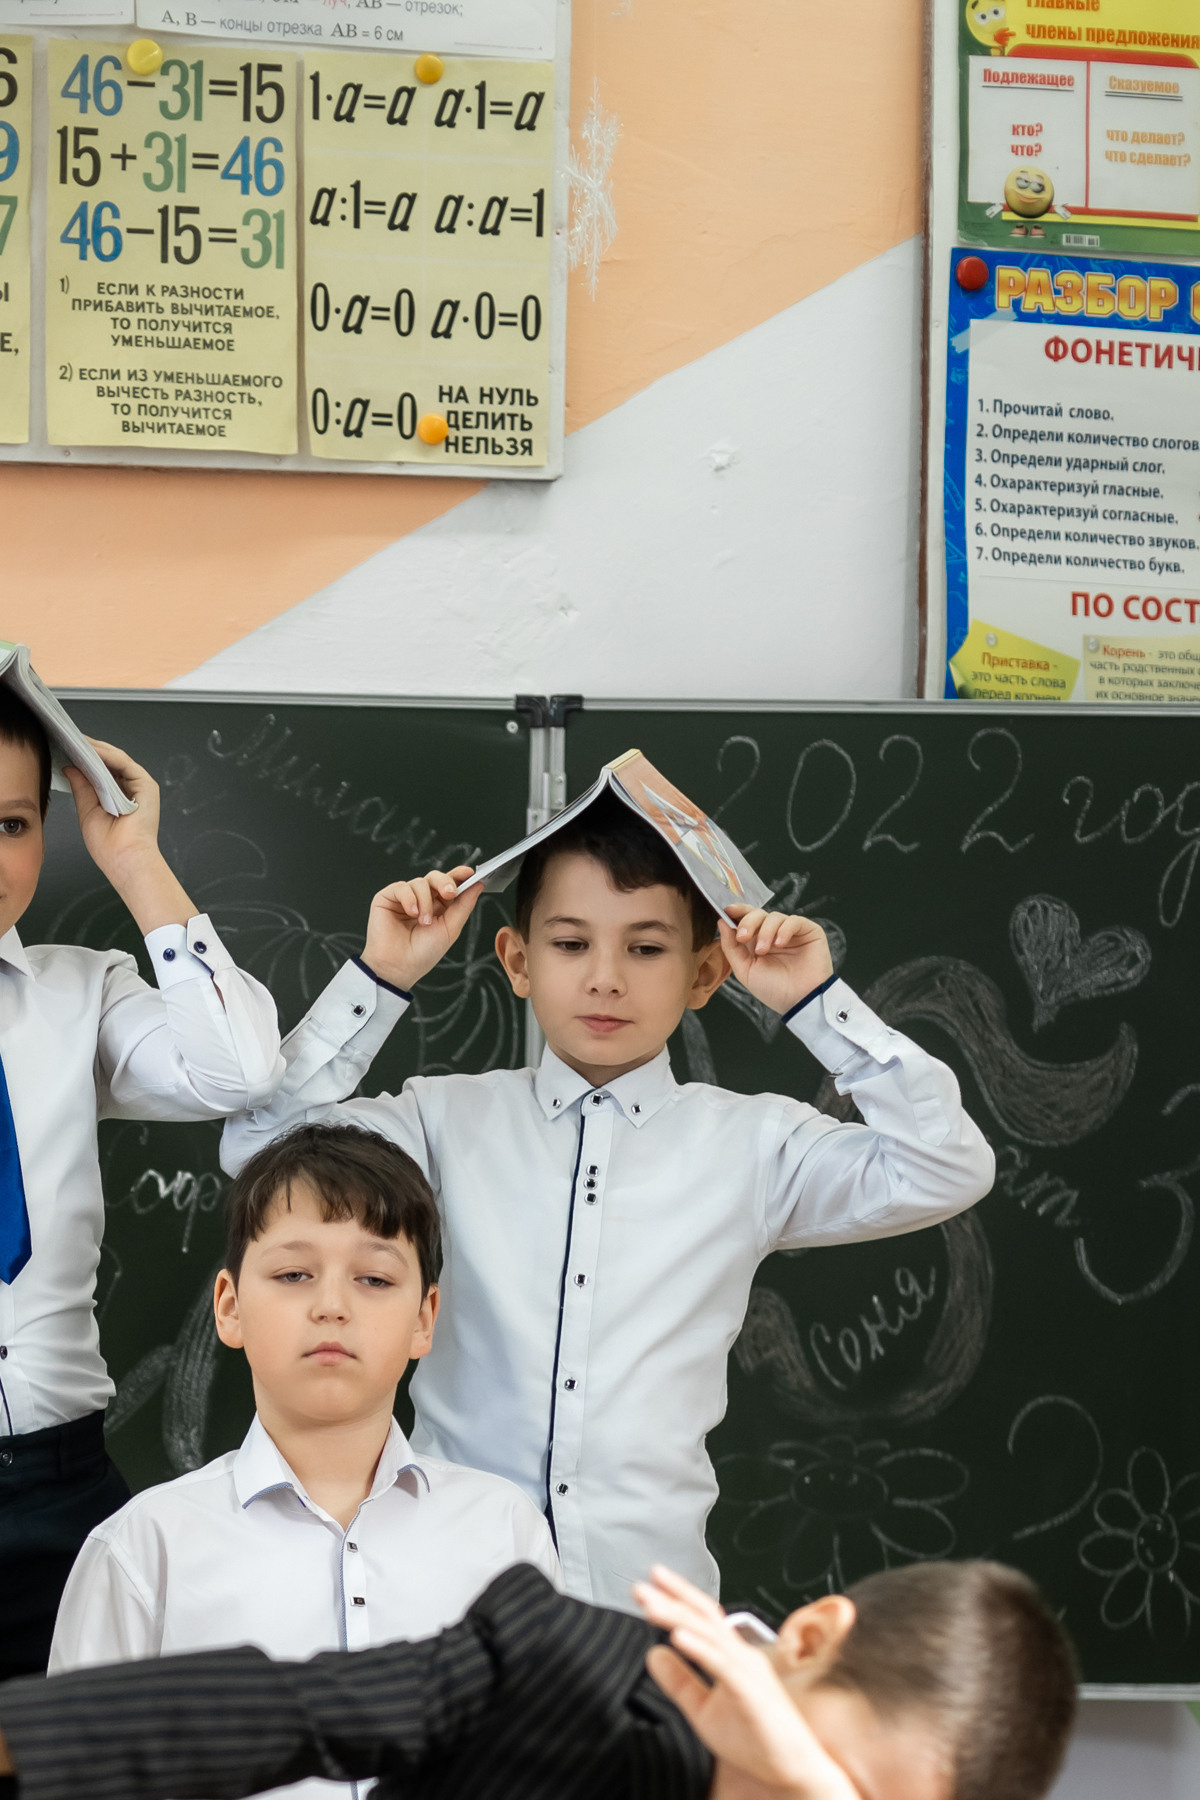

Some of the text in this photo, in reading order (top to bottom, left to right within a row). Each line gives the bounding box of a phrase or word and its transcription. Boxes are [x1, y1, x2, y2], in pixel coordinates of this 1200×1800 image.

[219, 17, 262, 33] концы
[267, 20, 323, 37] отрезка
[374, 26, 383, 41] 6
[386, 29, 404, 41] см
[1026, 24, 1200, 49] члены предложения
[983, 68, 1075, 88] Подлежащее
[1108, 75, 1180, 94] Сказуемое
[1012, 123, 1043, 137] кто?
[1106, 129, 1185, 146] что делает?
[1010, 143, 1043, 157] что?
[1105, 150, 1191, 167] что сделает?
[97, 282, 139, 296] ЕСЛИ
[146, 284, 155, 296] К
[161, 286, 244, 300] РАЗНОСТИ
[995, 265, 1179, 322] РАЗБОР
[72, 298, 280, 320] ПРИБАВИТЬ ВЫЧИТАЕМОЕ,
[111, 317, 232, 334] ТО ПОЛУЧИТСЯ
[111, 335, 235, 351] УМЕНЬШАЕМОЕ
[59, 363, 283, 388] 2) ЕСЛИ ИЗ УМЕНЬШАЕМОГО
[97, 386, 263, 406] ВЫЧЕСТЬ РАЗНОСТЬ,
[437, 384, 539, 407] НА НУЛЬ
[111, 403, 232, 420] ТО ПОЛУЧИТСЯ
[978, 399, 1114, 421] 1. Прочитай слово.
[122, 421, 227, 437] ВЫЧИТАЕМОЕ
[446, 410, 533, 432] ДЕЛИТЬ
[444, 436, 533, 457] НЕЛЬЗЯ
[976, 424, 1200, 452] 2. Определи количество слогов
[975, 449, 1165, 475] 3. Определи ударный слог.
[975, 474, 1164, 499] 4. Охарактеризуй гласные.
[975, 499, 1179, 525] 5. Охарактеризуй согласные.
[975, 523, 1200, 551] 6. Определи количество звуков.
[976, 547, 1185, 575] 7. Определи количество букв.
[1071, 592, 1114, 618] ПО
[982, 652, 1050, 671] Приставка
[1103, 645, 1146, 659] Корень
[1158, 650, 1176, 660] это
[1090, 661, 1195, 675] часть родственных
[971, 671, 1066, 689] это часть слова
[1108, 677, 1154, 688] которых
[710, 726, 1035, 855] 2022
